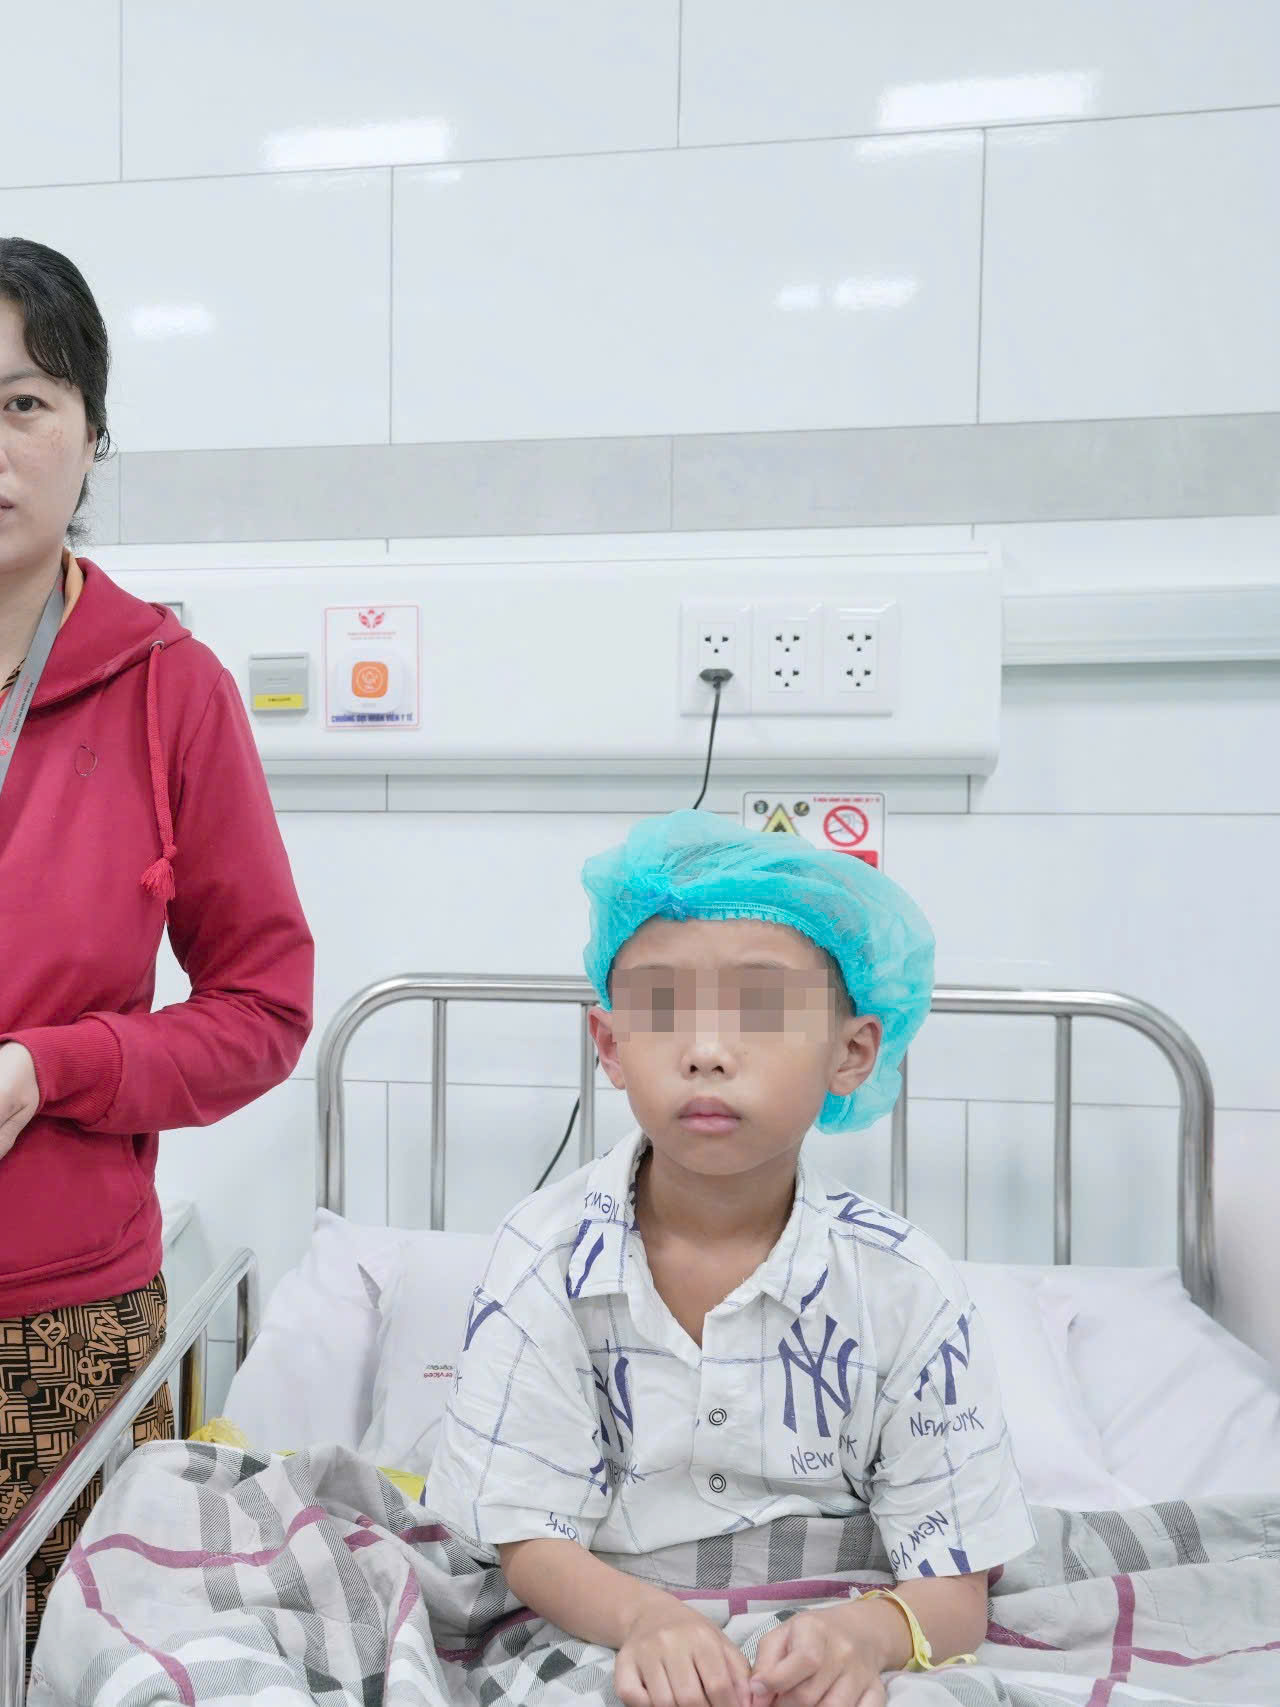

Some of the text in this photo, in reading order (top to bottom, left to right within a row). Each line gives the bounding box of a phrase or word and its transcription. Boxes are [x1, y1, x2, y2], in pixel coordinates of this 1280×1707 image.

[59, 1309, 127, 1416] B & W
[791, 1446, 834, 1475] New
[908, 1510, 949, 1550] New
